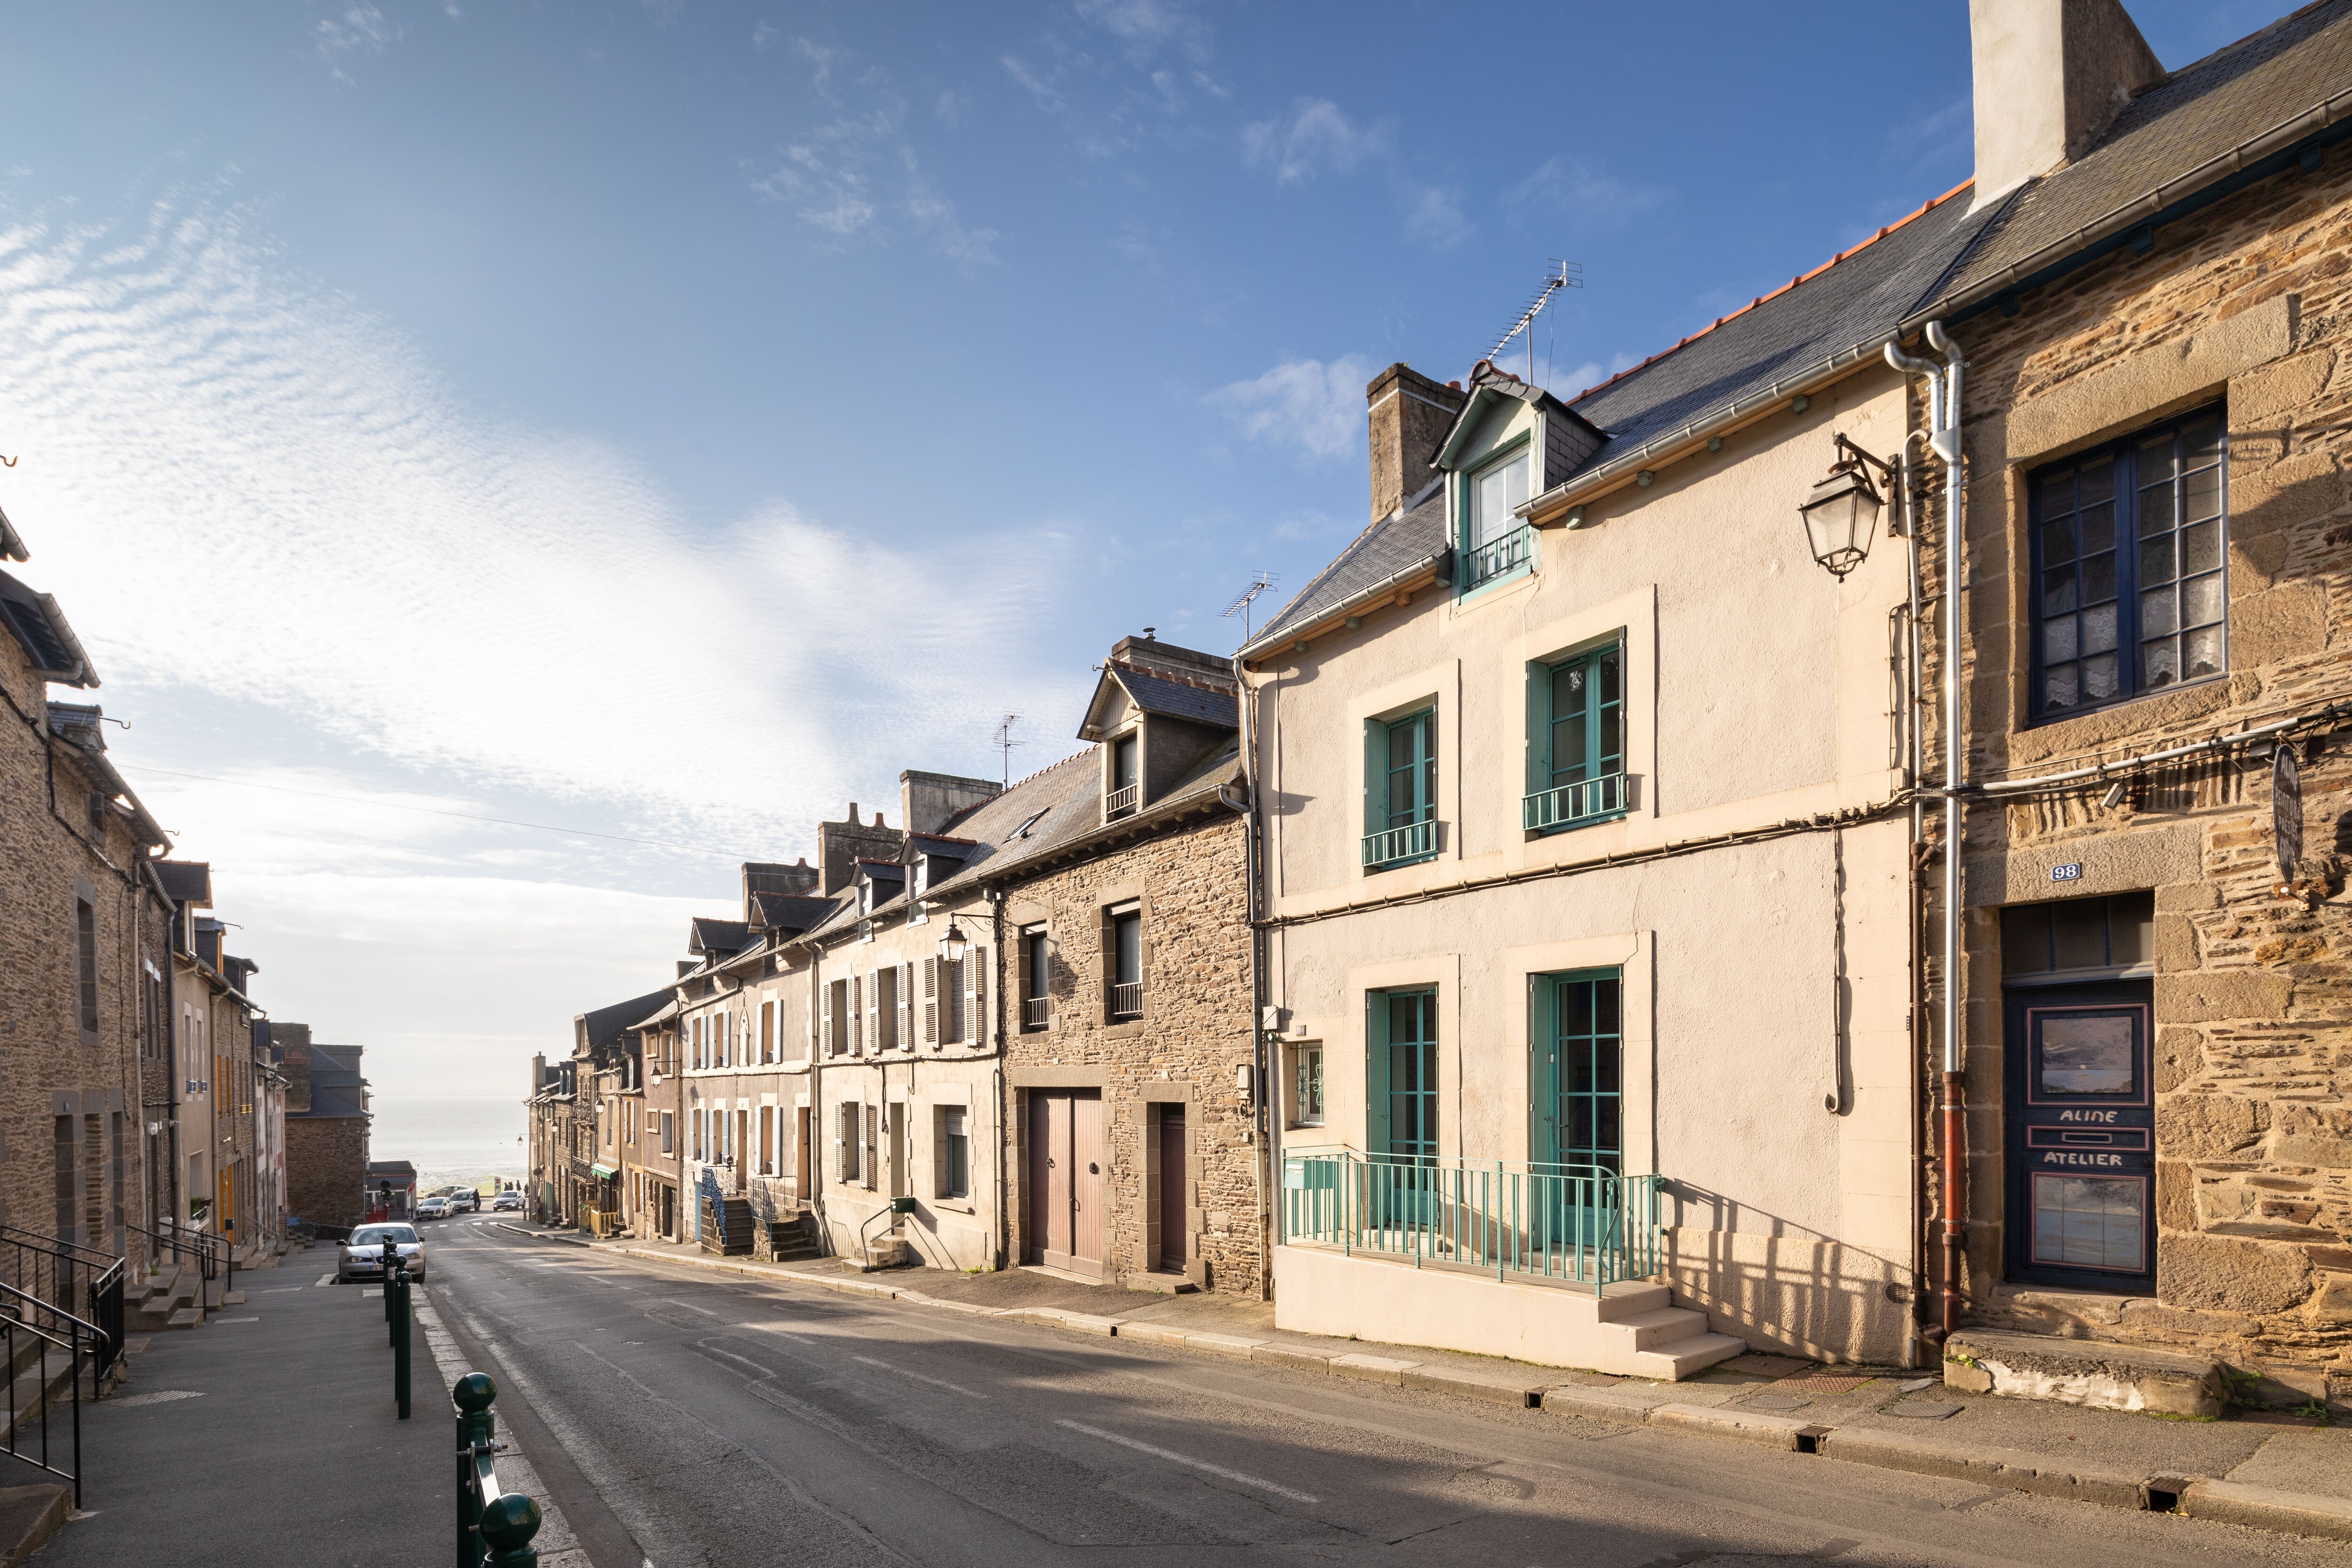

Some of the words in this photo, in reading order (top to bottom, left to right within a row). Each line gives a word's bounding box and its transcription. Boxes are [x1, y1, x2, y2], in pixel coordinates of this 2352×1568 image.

[2280, 836, 2293, 868] EXPO
[2055, 865, 2076, 879] 98
[1296, 1026, 1305, 1035] 100
[2060, 1110, 2118, 1123] ALINE
[2043, 1151, 2122, 1166] ATELIER
